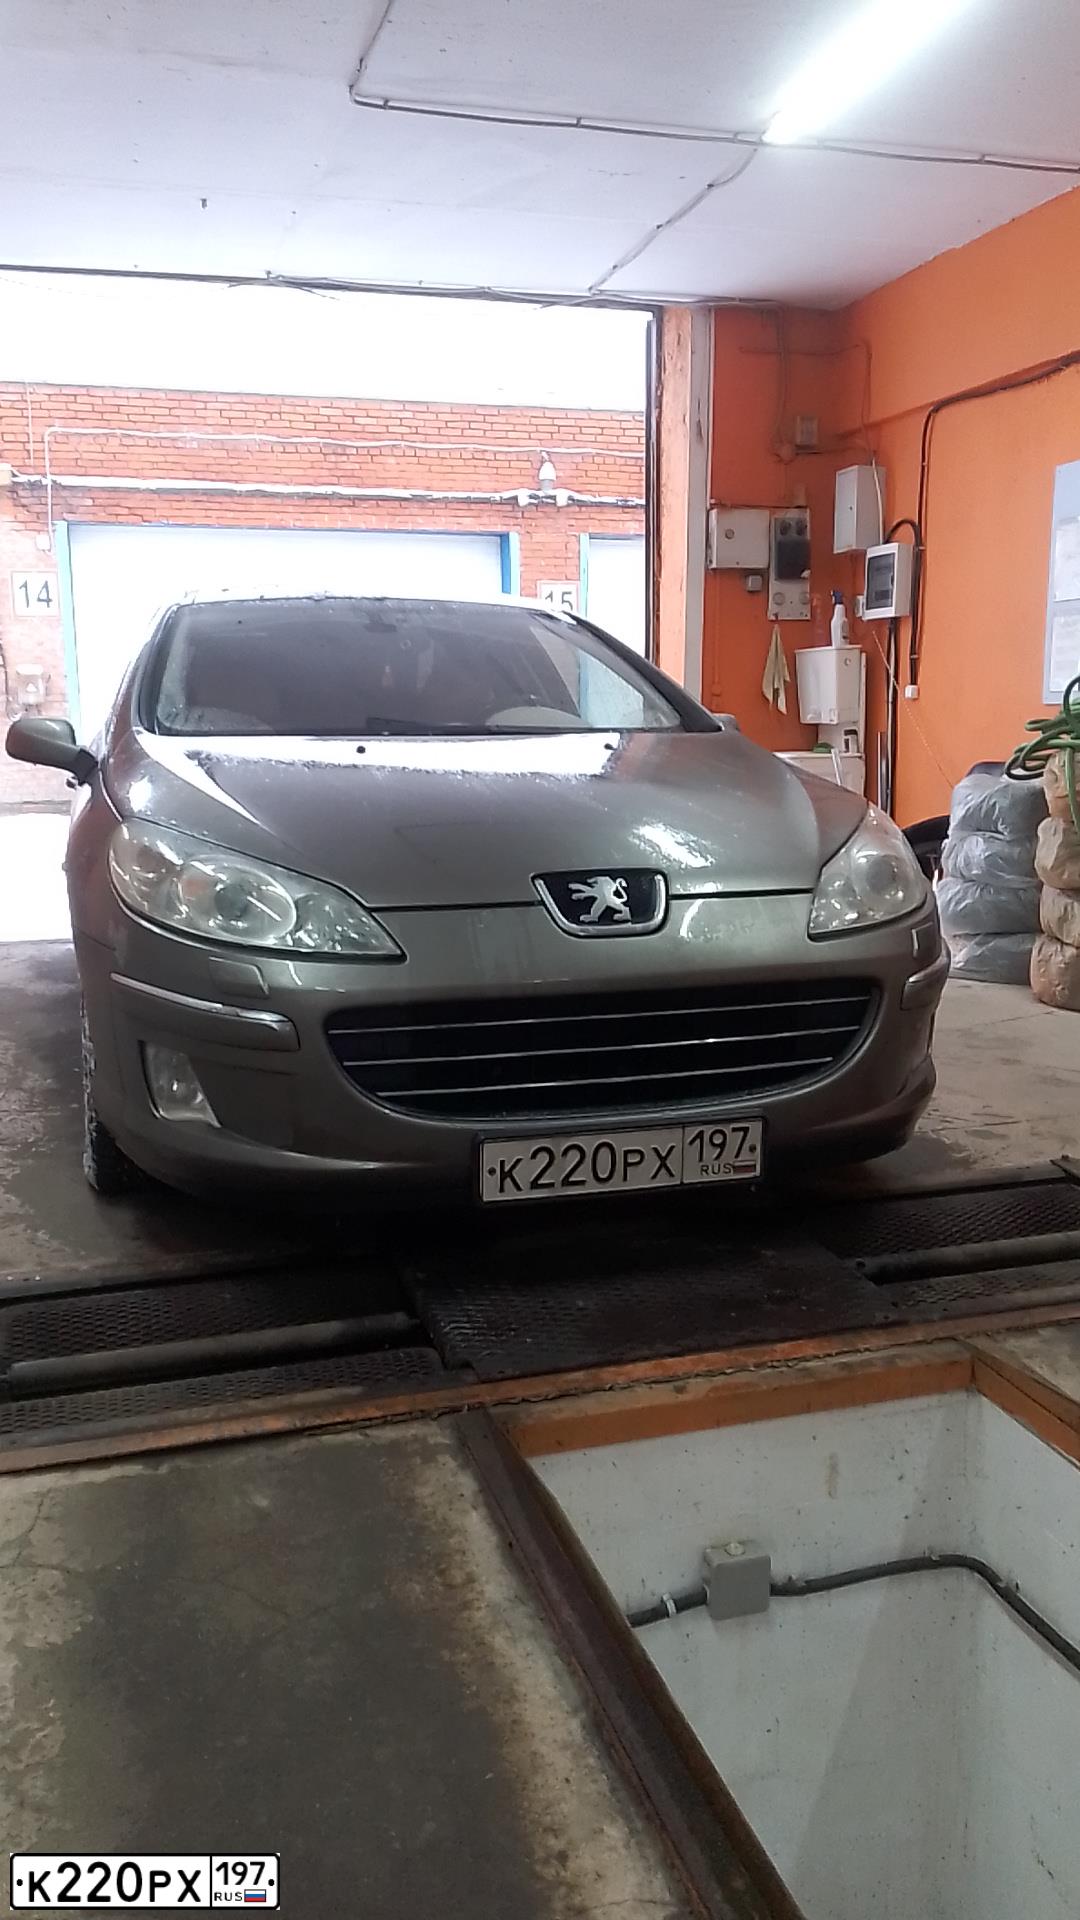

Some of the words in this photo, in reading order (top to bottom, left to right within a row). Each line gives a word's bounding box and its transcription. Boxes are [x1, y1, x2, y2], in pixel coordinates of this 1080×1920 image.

[19, 580, 53, 608] 14
[687, 1125, 750, 1163] 197
[700, 1162, 733, 1177] RUS
